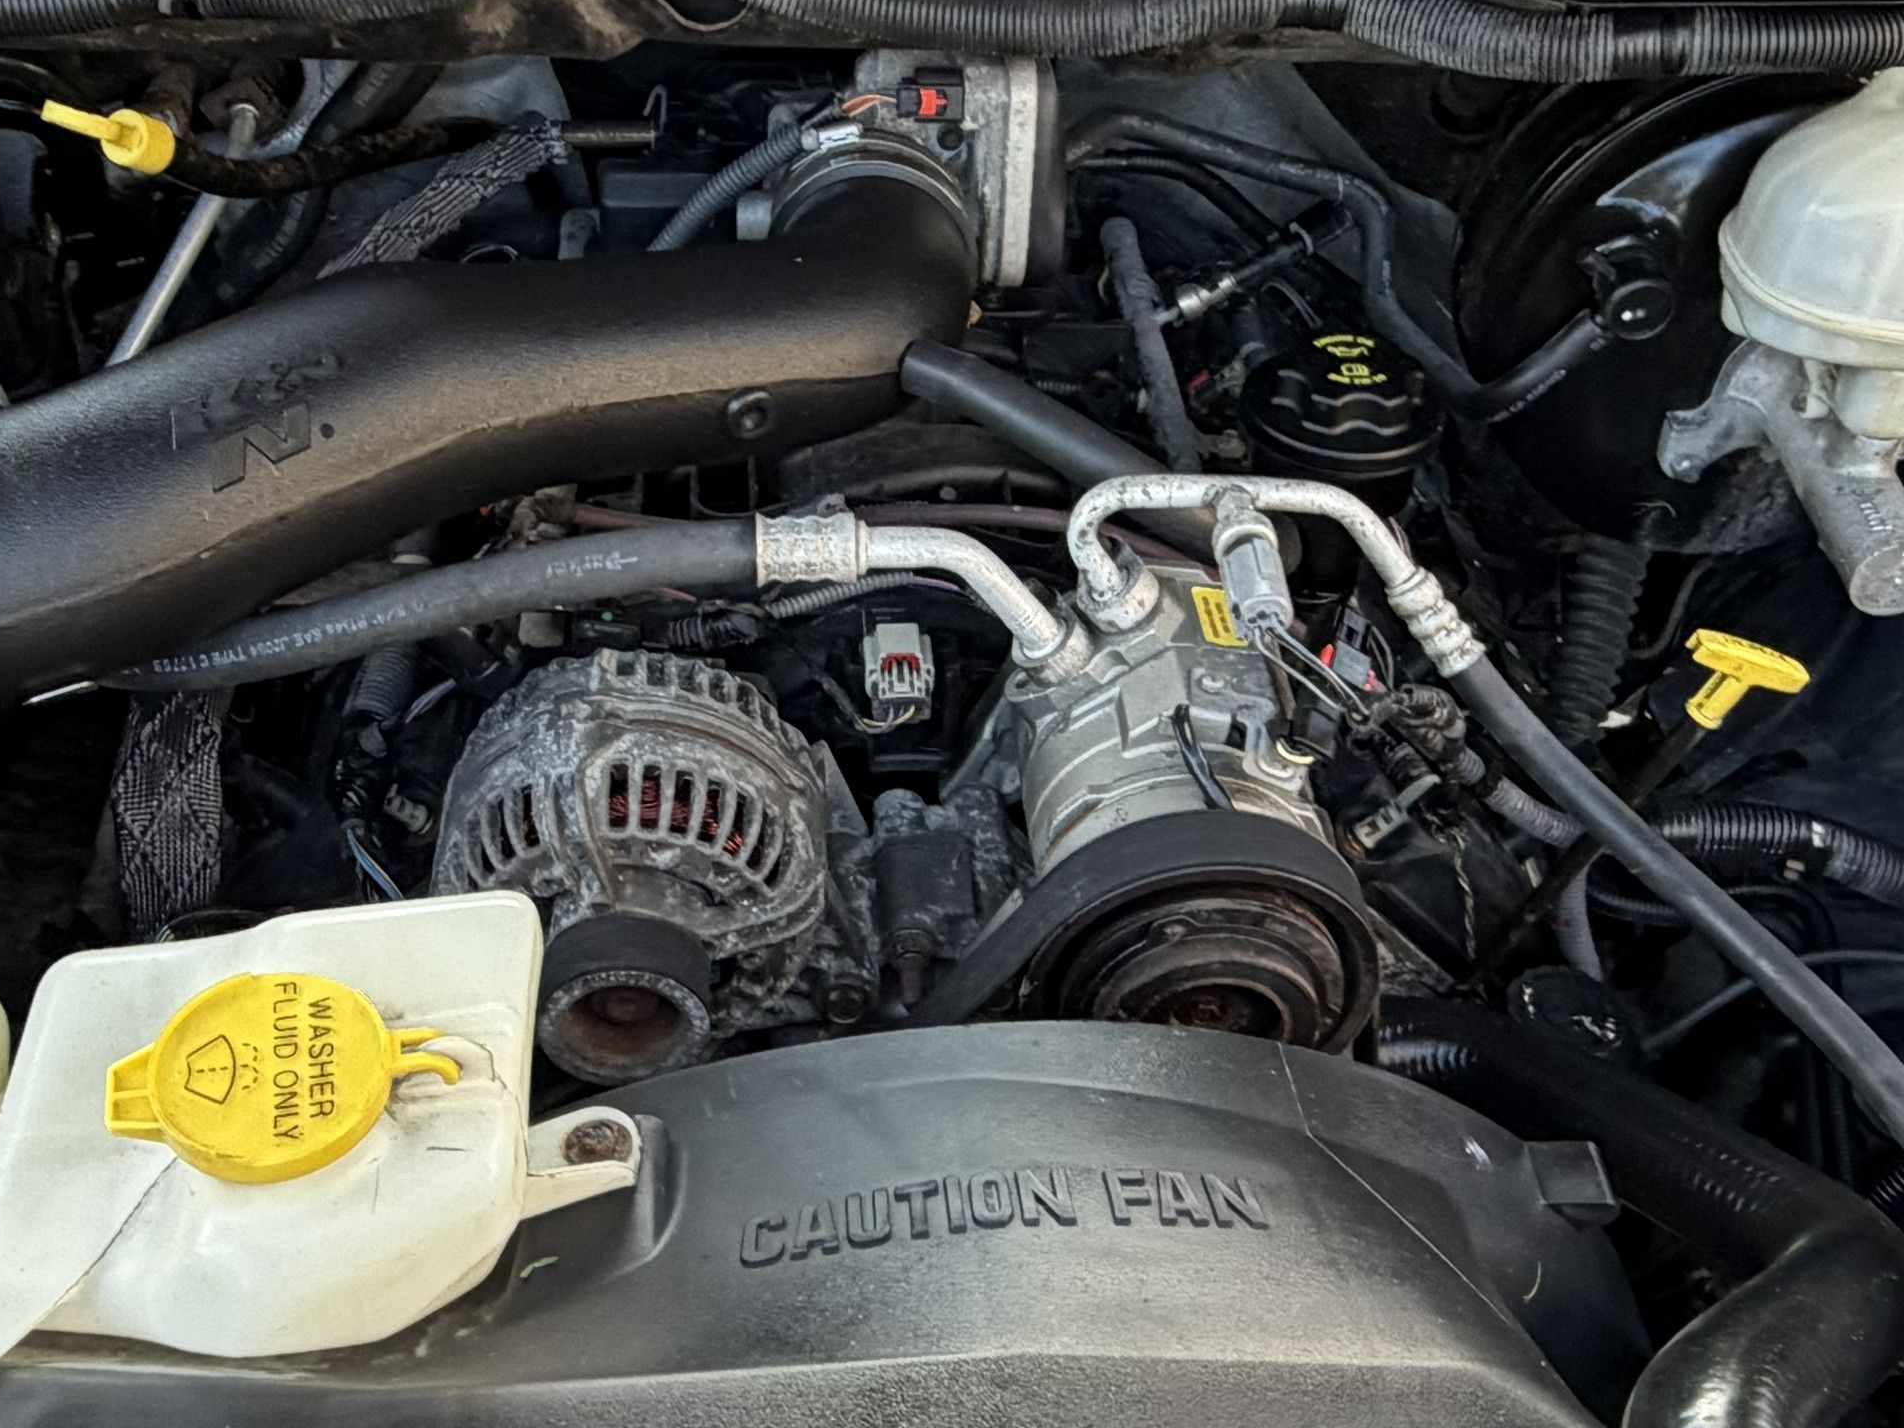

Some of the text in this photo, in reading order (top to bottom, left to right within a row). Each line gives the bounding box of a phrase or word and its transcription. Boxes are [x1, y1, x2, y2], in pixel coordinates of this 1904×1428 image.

[272, 981, 301, 1140] FLUID ONLY
[307, 996, 336, 1119] WASHER
[739, 1166, 1270, 1269] CAUTION FAN
